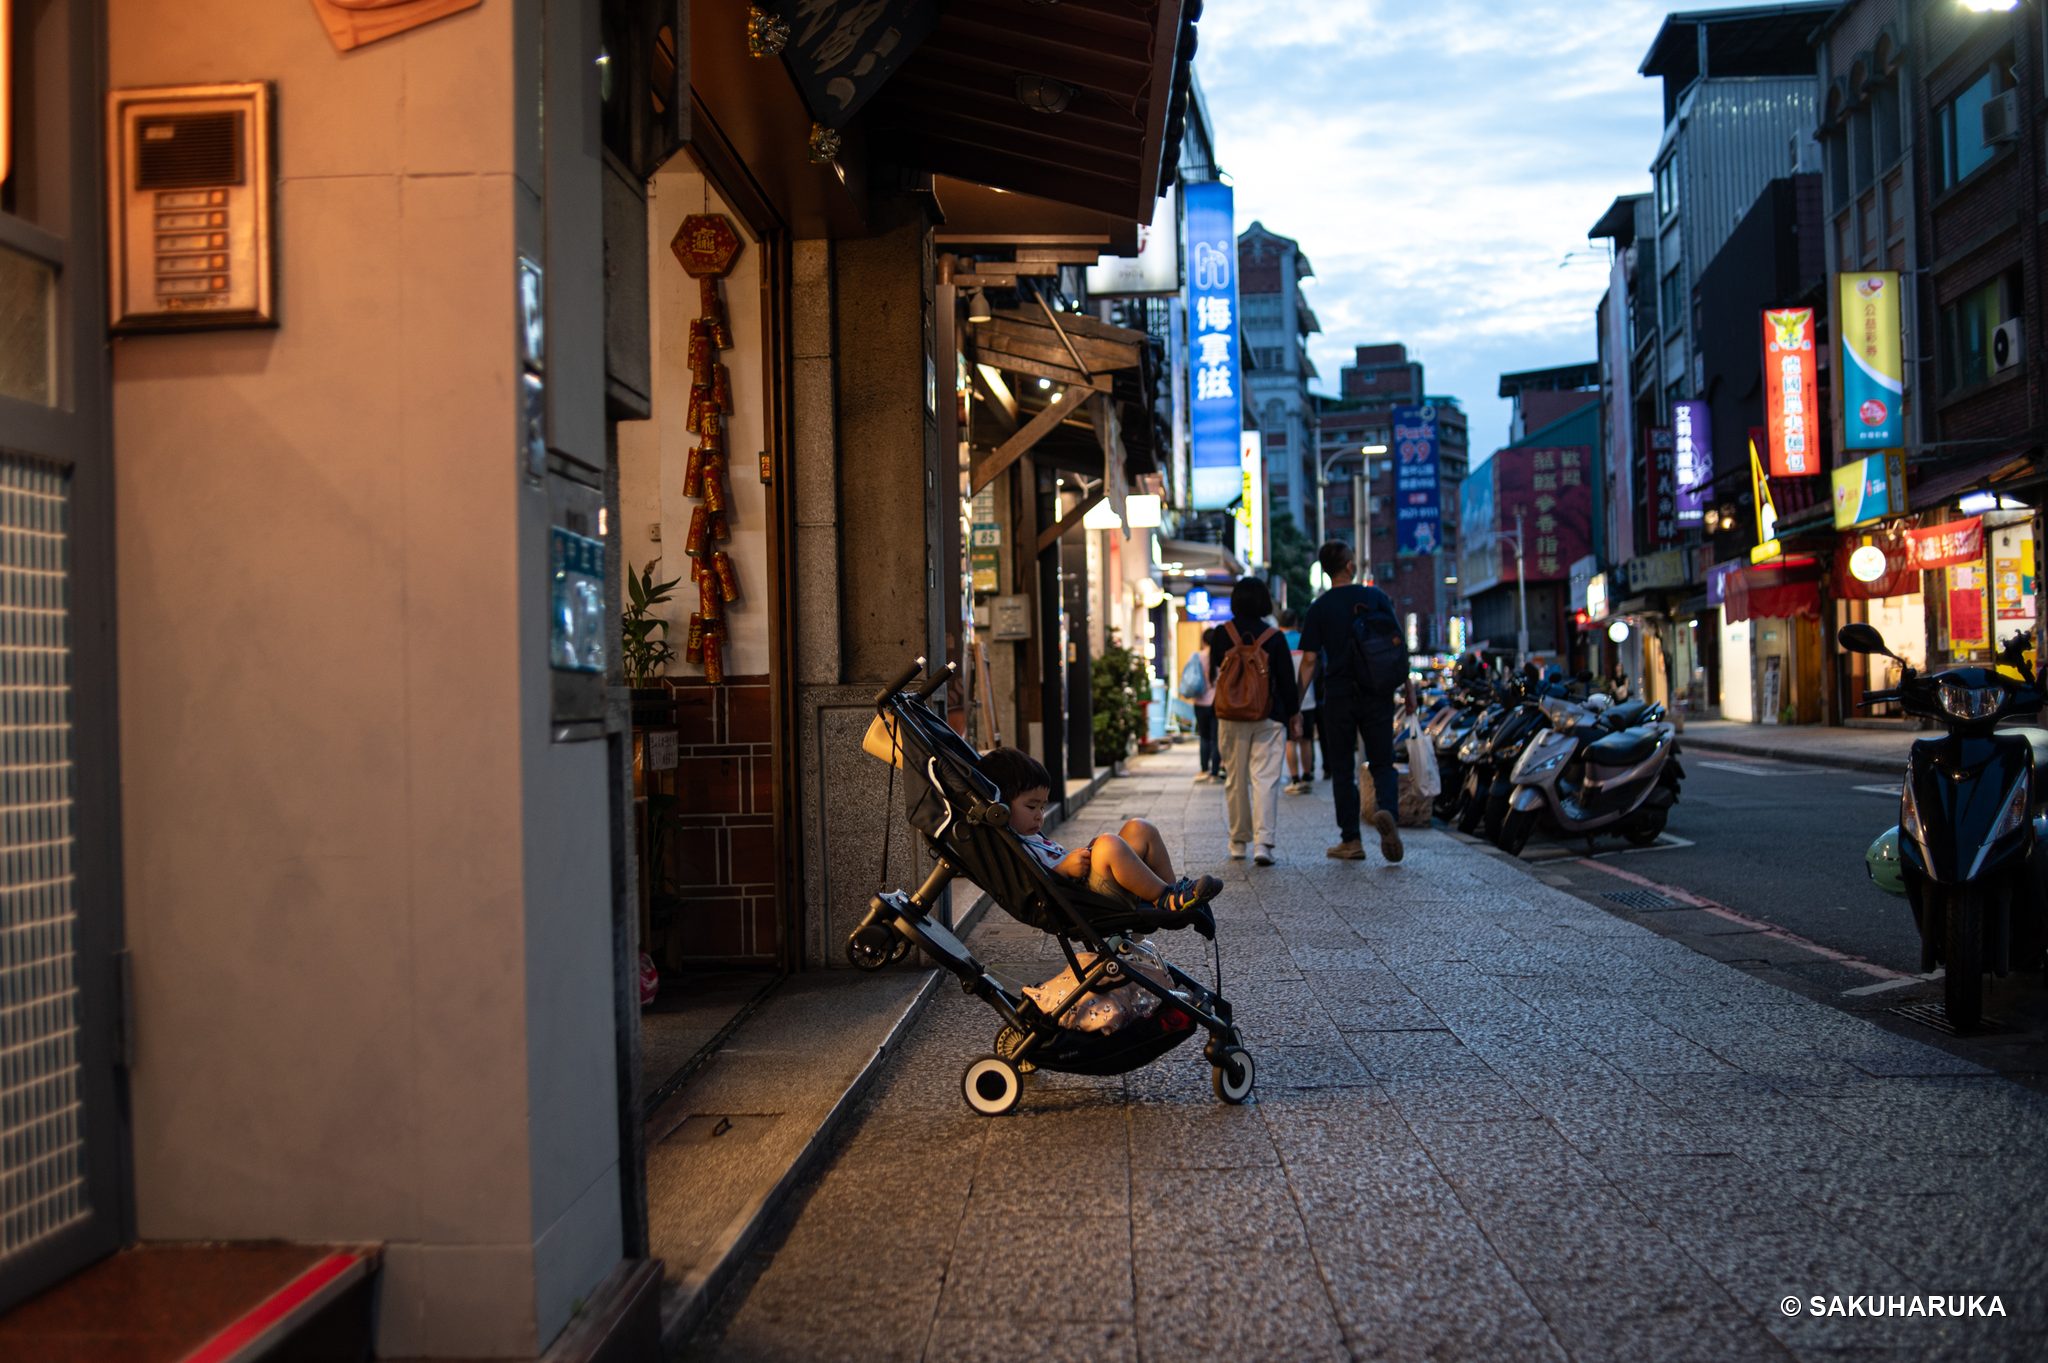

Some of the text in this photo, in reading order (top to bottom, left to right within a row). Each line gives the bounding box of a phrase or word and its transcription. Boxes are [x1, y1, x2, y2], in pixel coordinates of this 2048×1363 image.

[1197, 296, 1232, 400] 海拿滋
[1401, 440, 1430, 463] 99
[980, 530, 996, 544] 85
